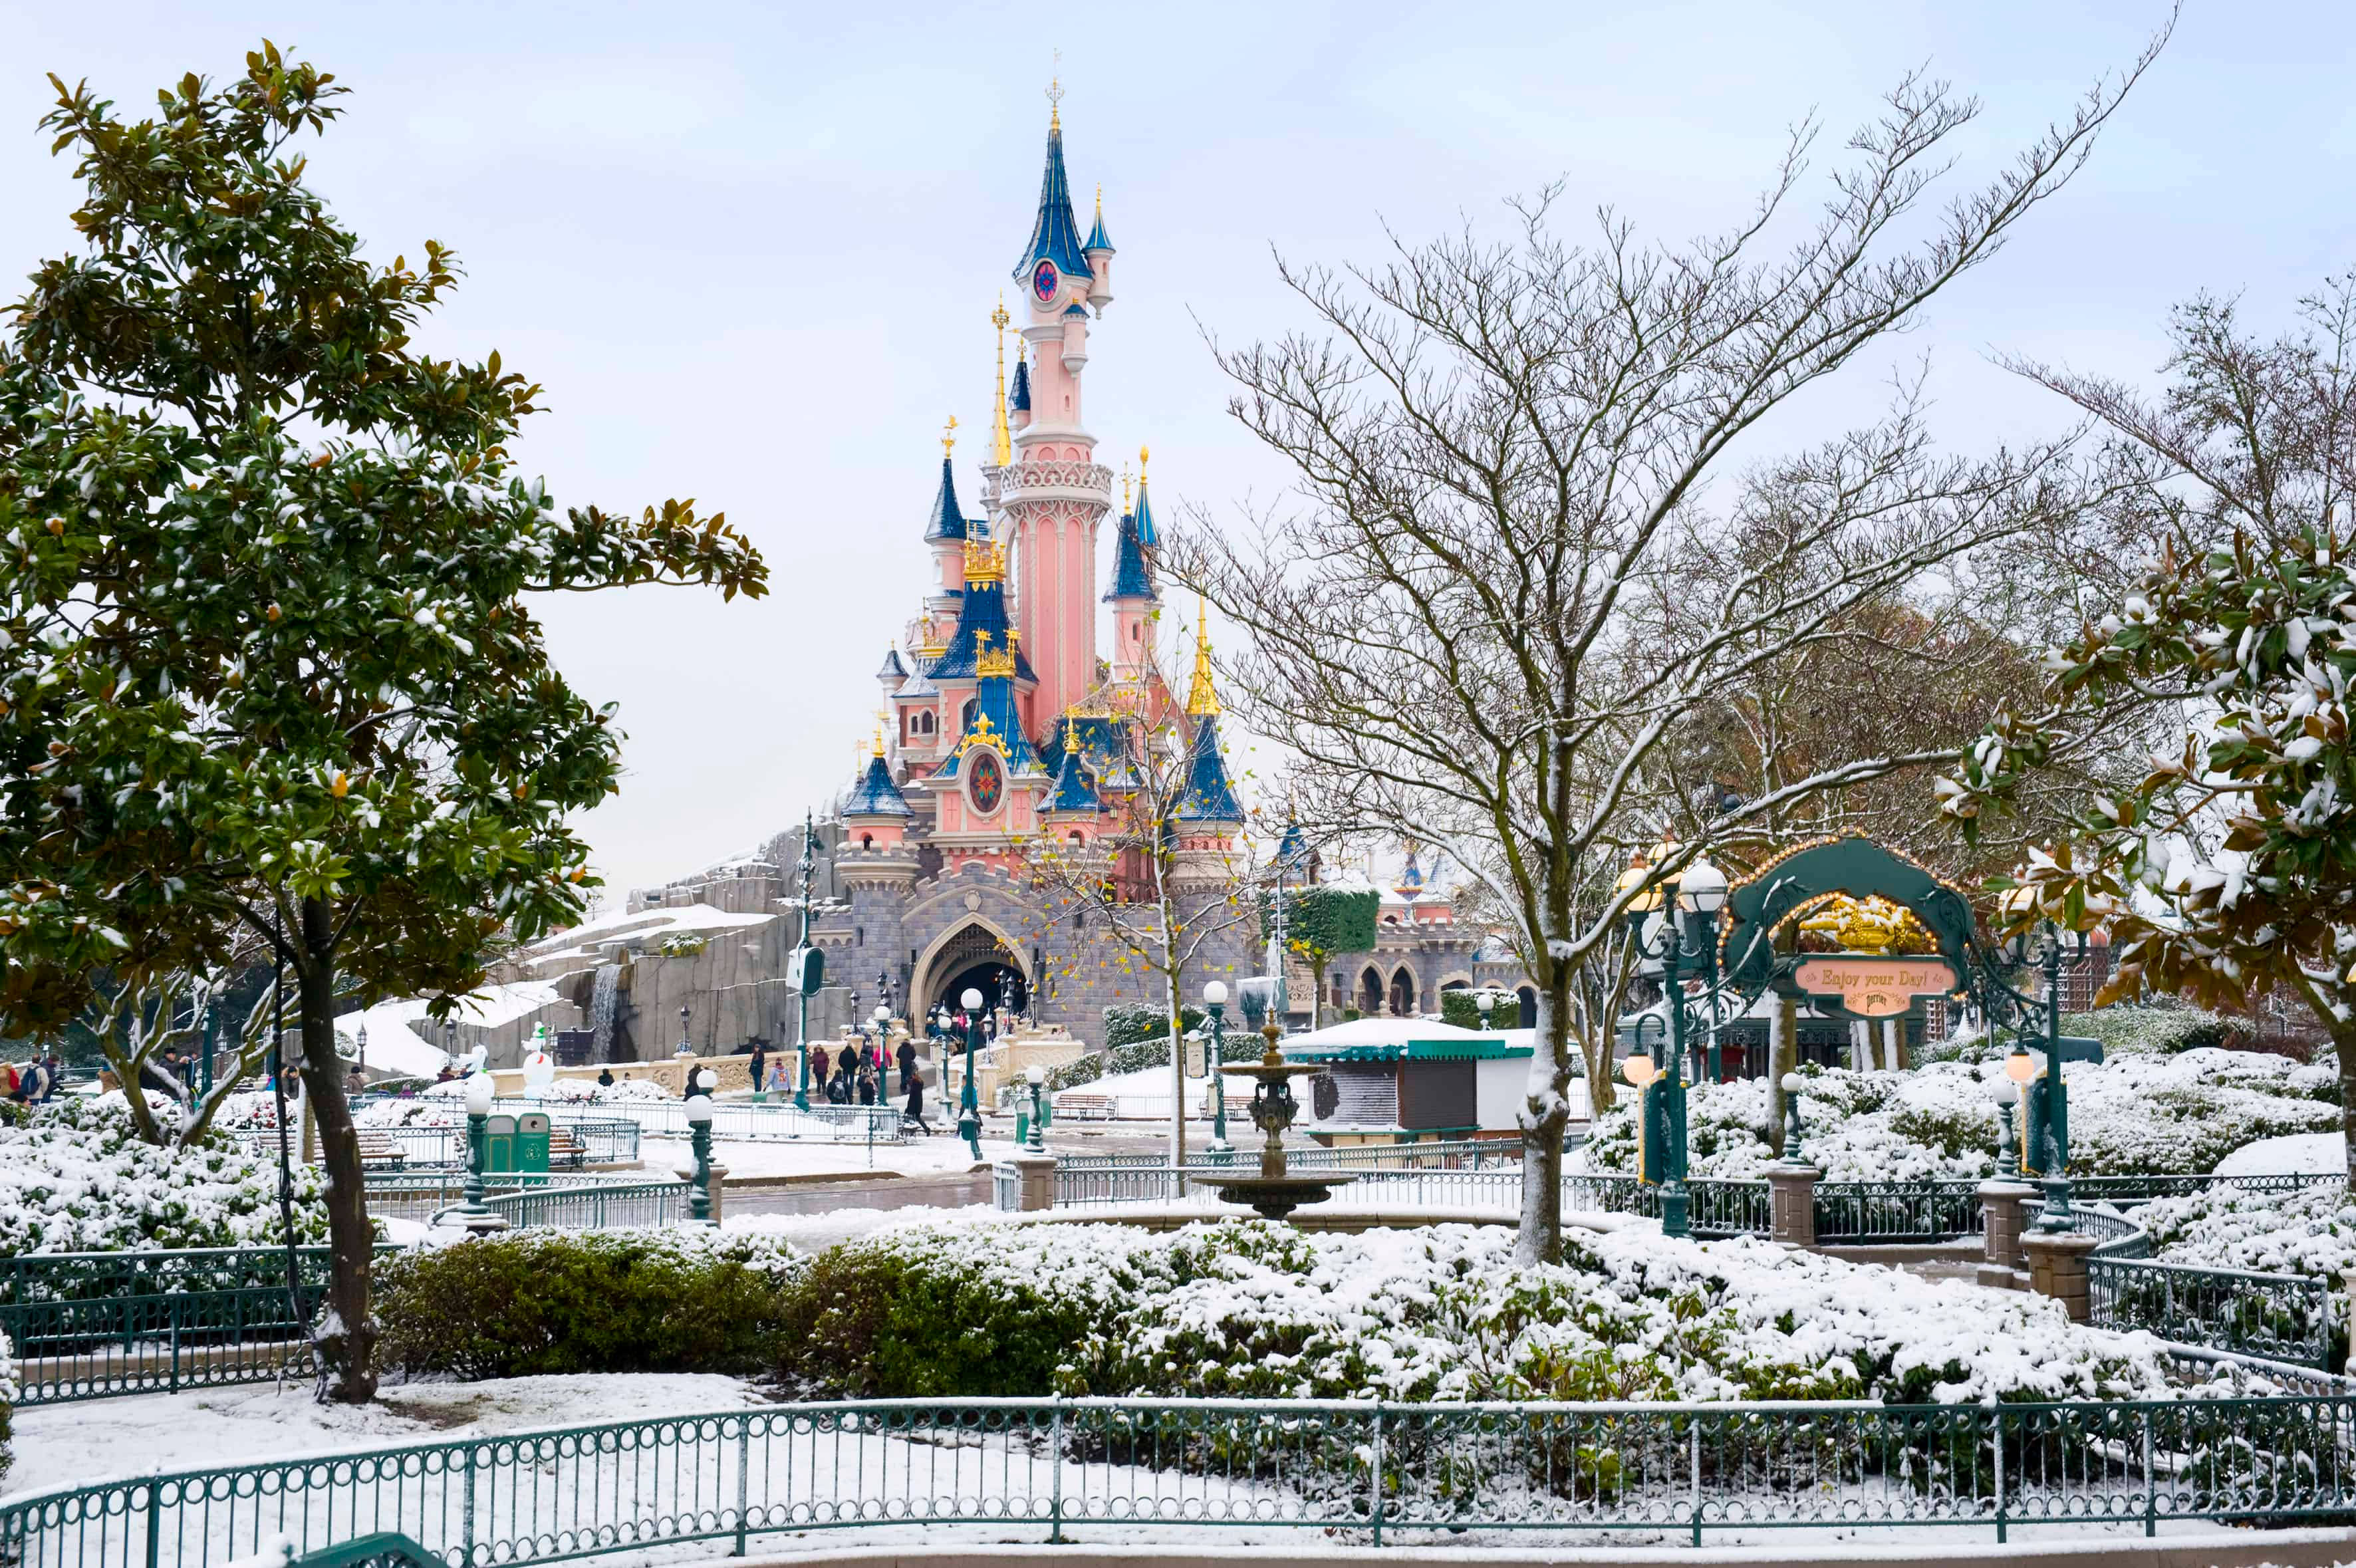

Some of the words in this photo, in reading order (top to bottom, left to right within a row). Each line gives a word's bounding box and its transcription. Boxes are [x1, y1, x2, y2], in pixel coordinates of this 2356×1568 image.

[1821, 969, 1860, 989] Enjoy
[1865, 975, 1894, 987] your
[1898, 970, 1928, 988] Day!
